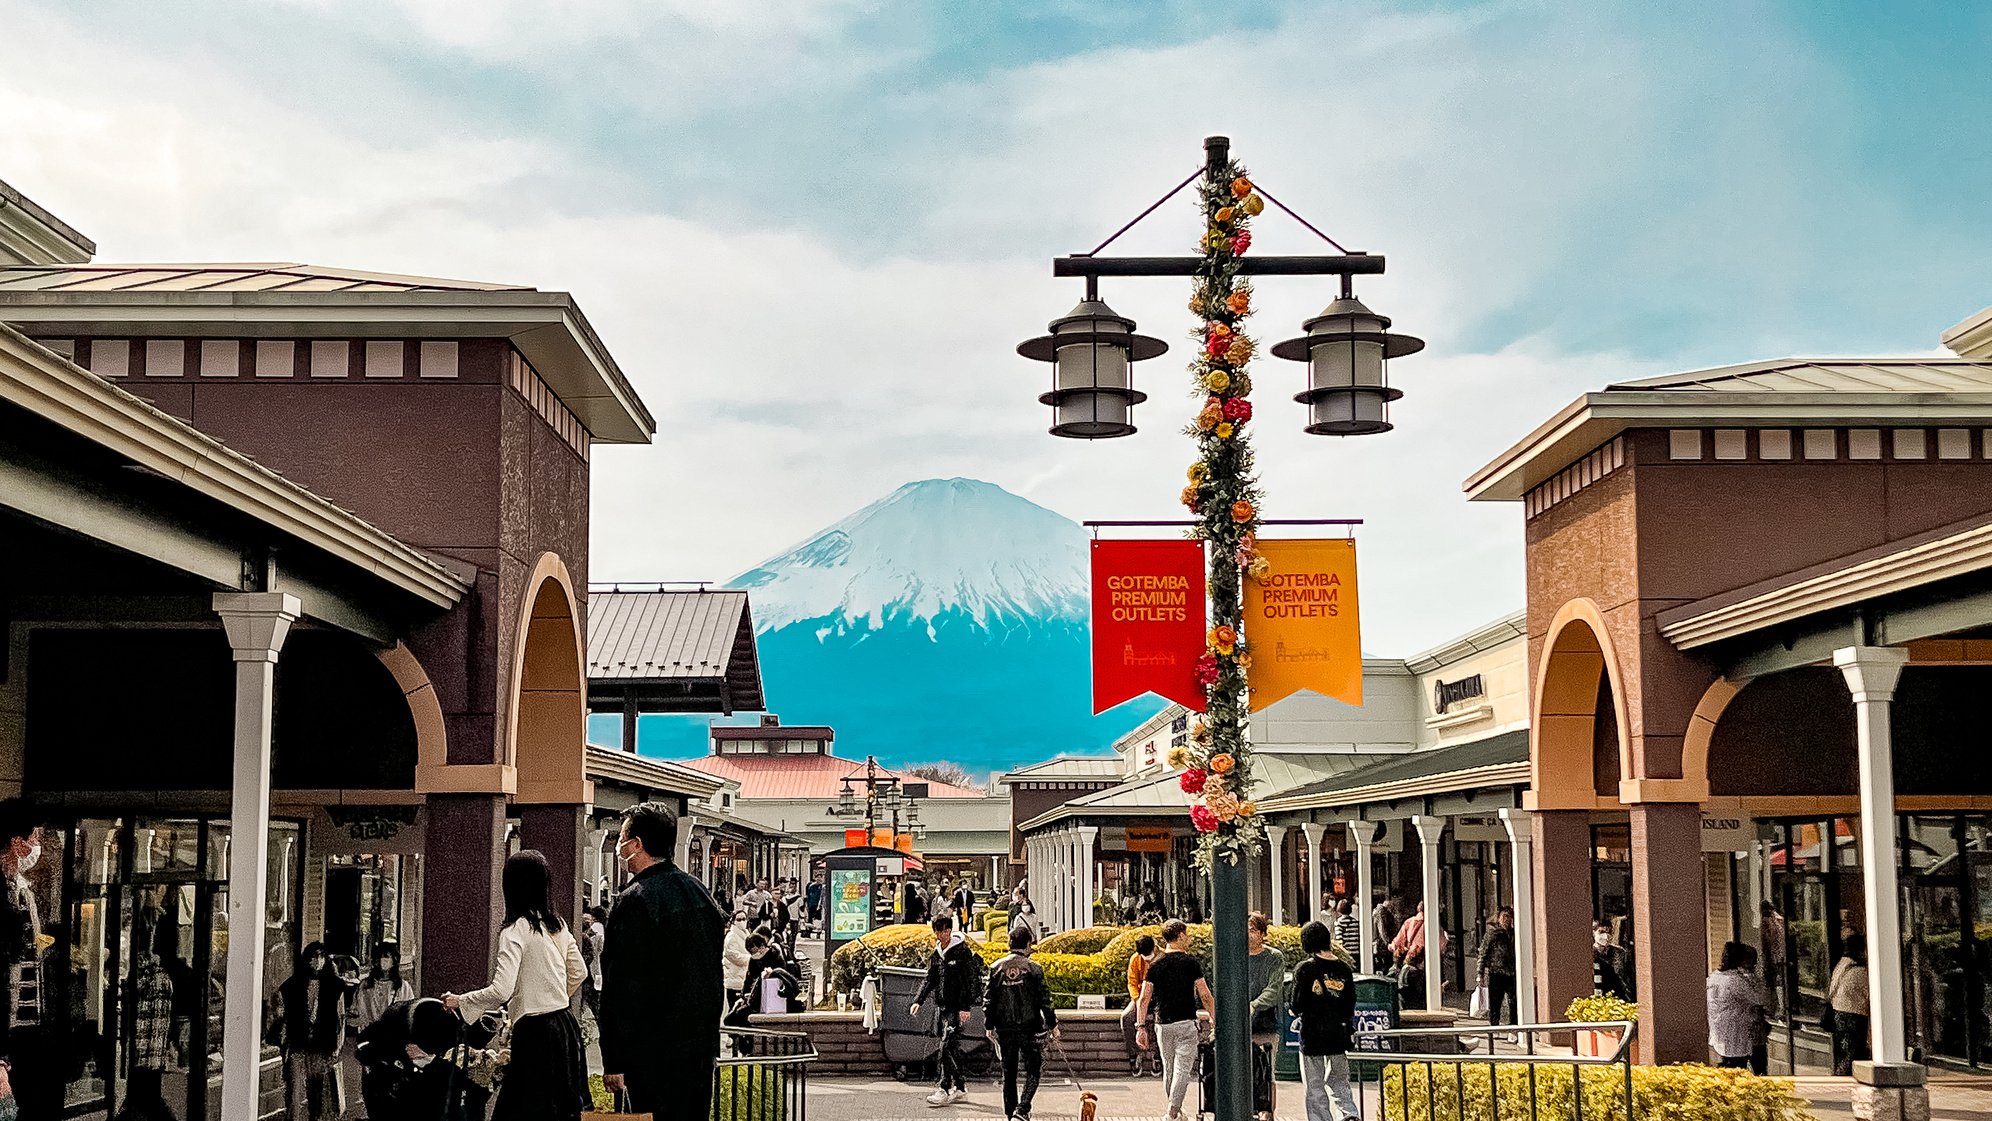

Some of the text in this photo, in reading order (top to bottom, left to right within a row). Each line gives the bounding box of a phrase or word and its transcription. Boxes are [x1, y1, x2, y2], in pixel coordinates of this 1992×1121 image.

[1107, 575, 1190, 590] GOTEMBA
[1259, 573, 1341, 587] GOTEMBA
[1112, 591, 1186, 605] PREMIUM
[1263, 589, 1338, 603] PREMIUM
[1112, 607, 1187, 622] OUTLETS
[1263, 604, 1339, 619] OUTLETS
[1702, 819, 1739, 830] ISLAND
